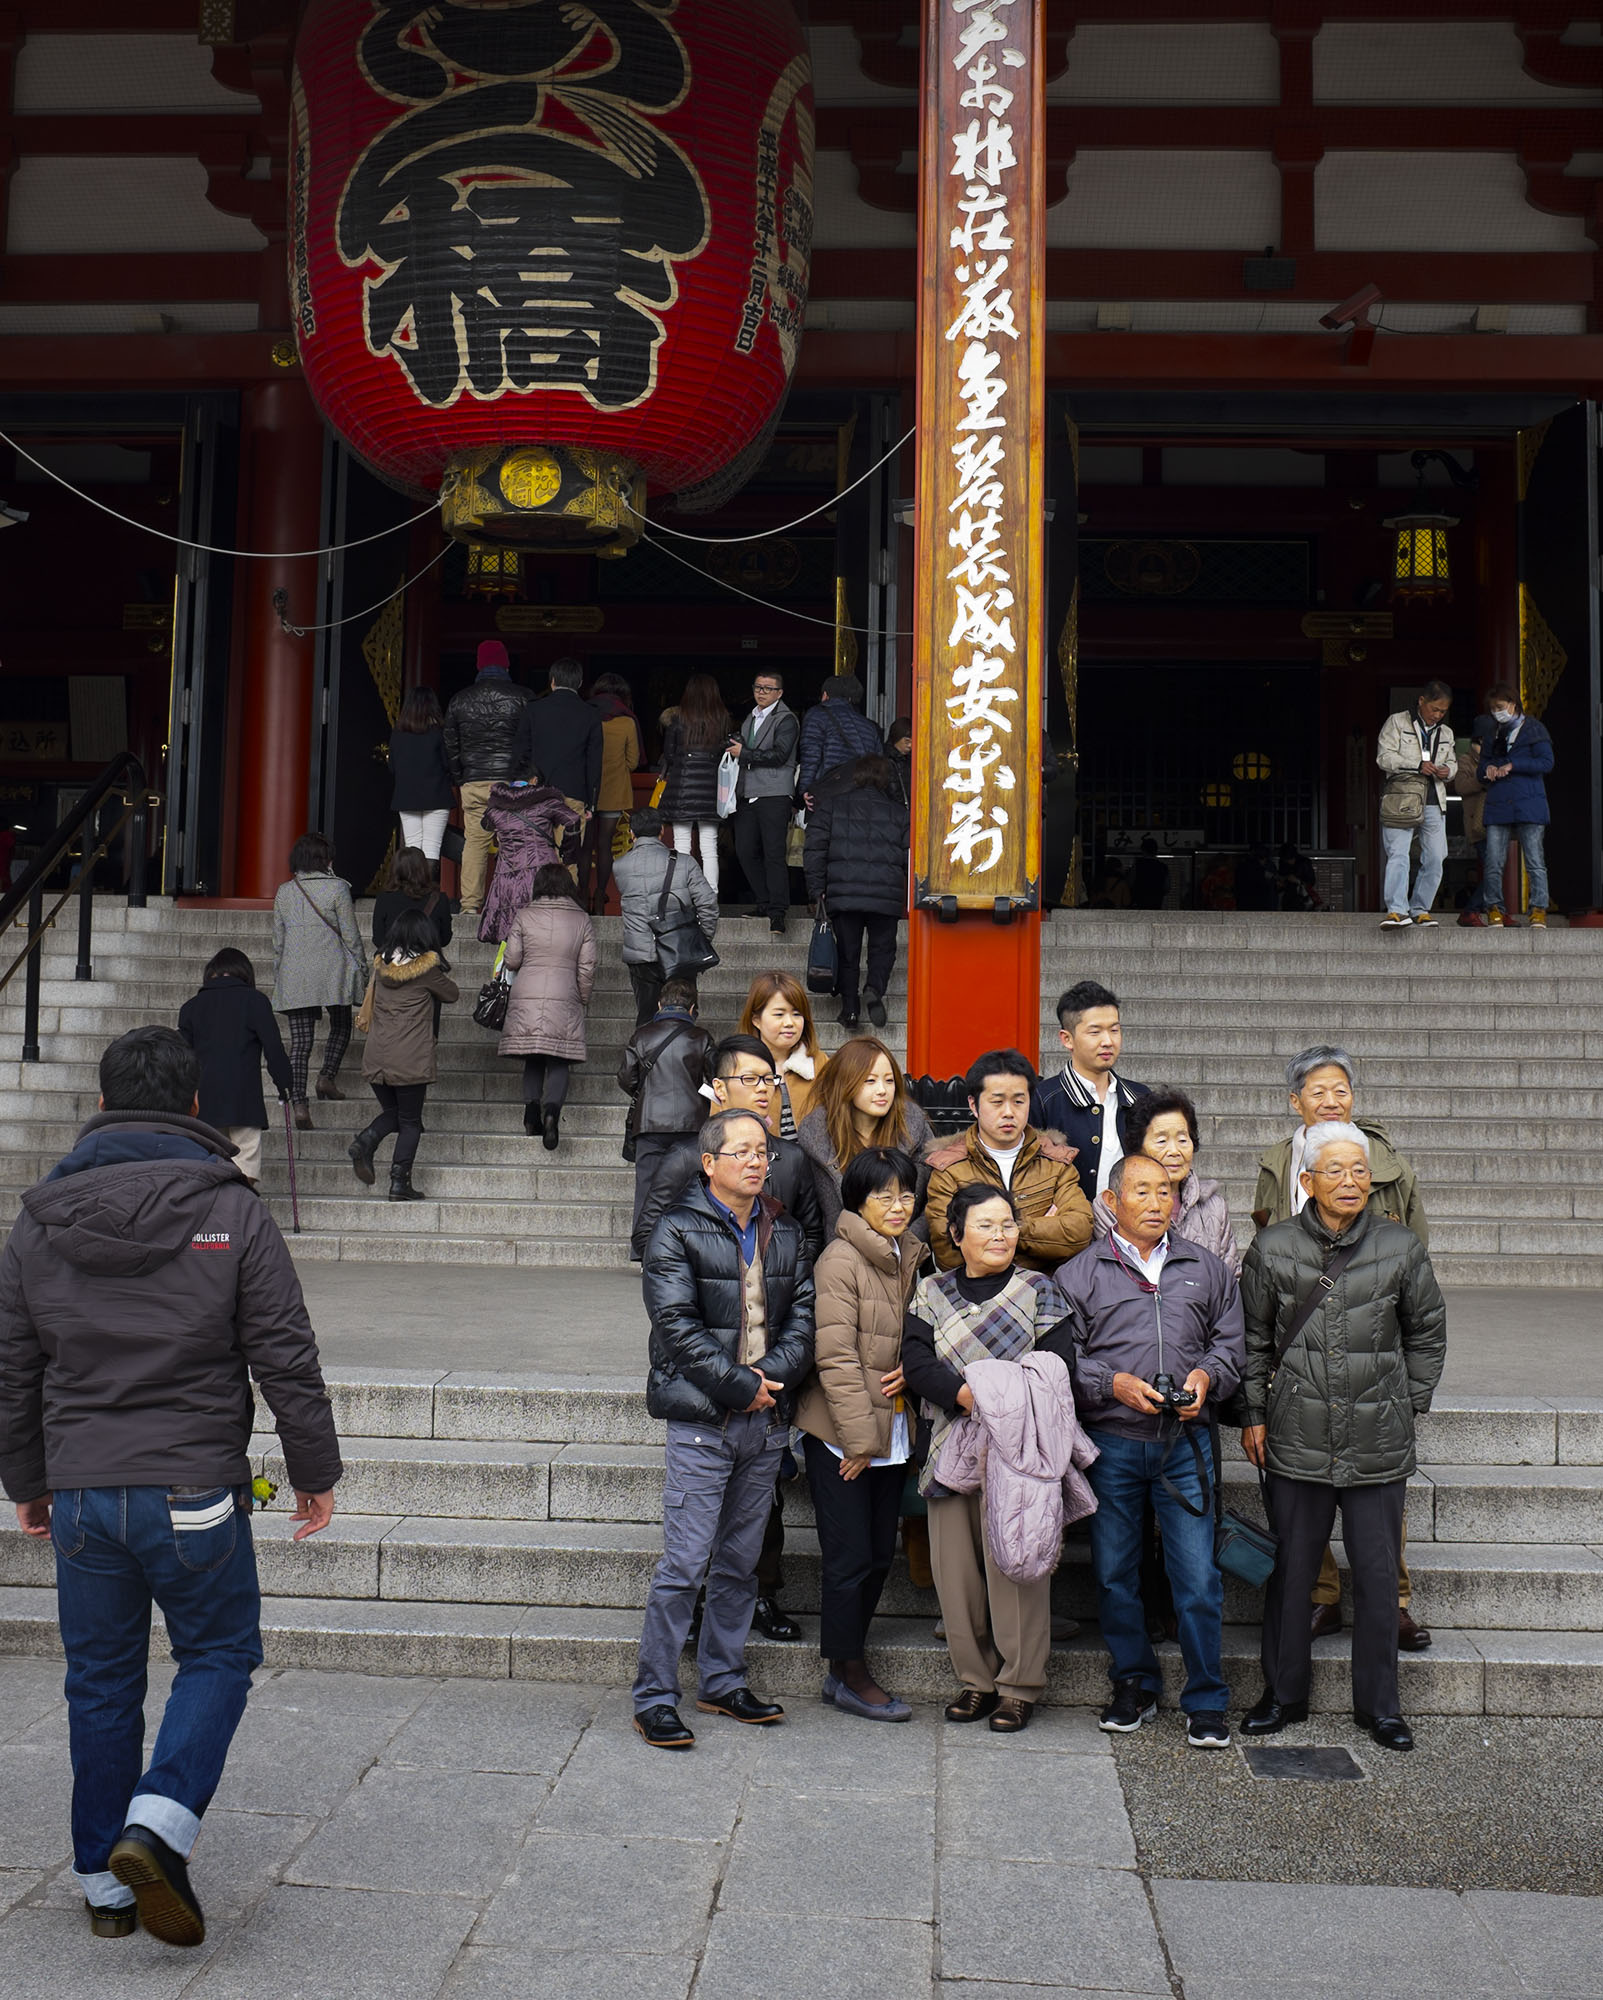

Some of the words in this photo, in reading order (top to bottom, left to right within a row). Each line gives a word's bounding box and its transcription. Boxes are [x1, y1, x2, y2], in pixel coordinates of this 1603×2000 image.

[0, 729, 57, 752] 込所
[192, 1233, 230, 1243] HOLLISTER
[192, 1242, 231, 1250] CALIFORNIA
